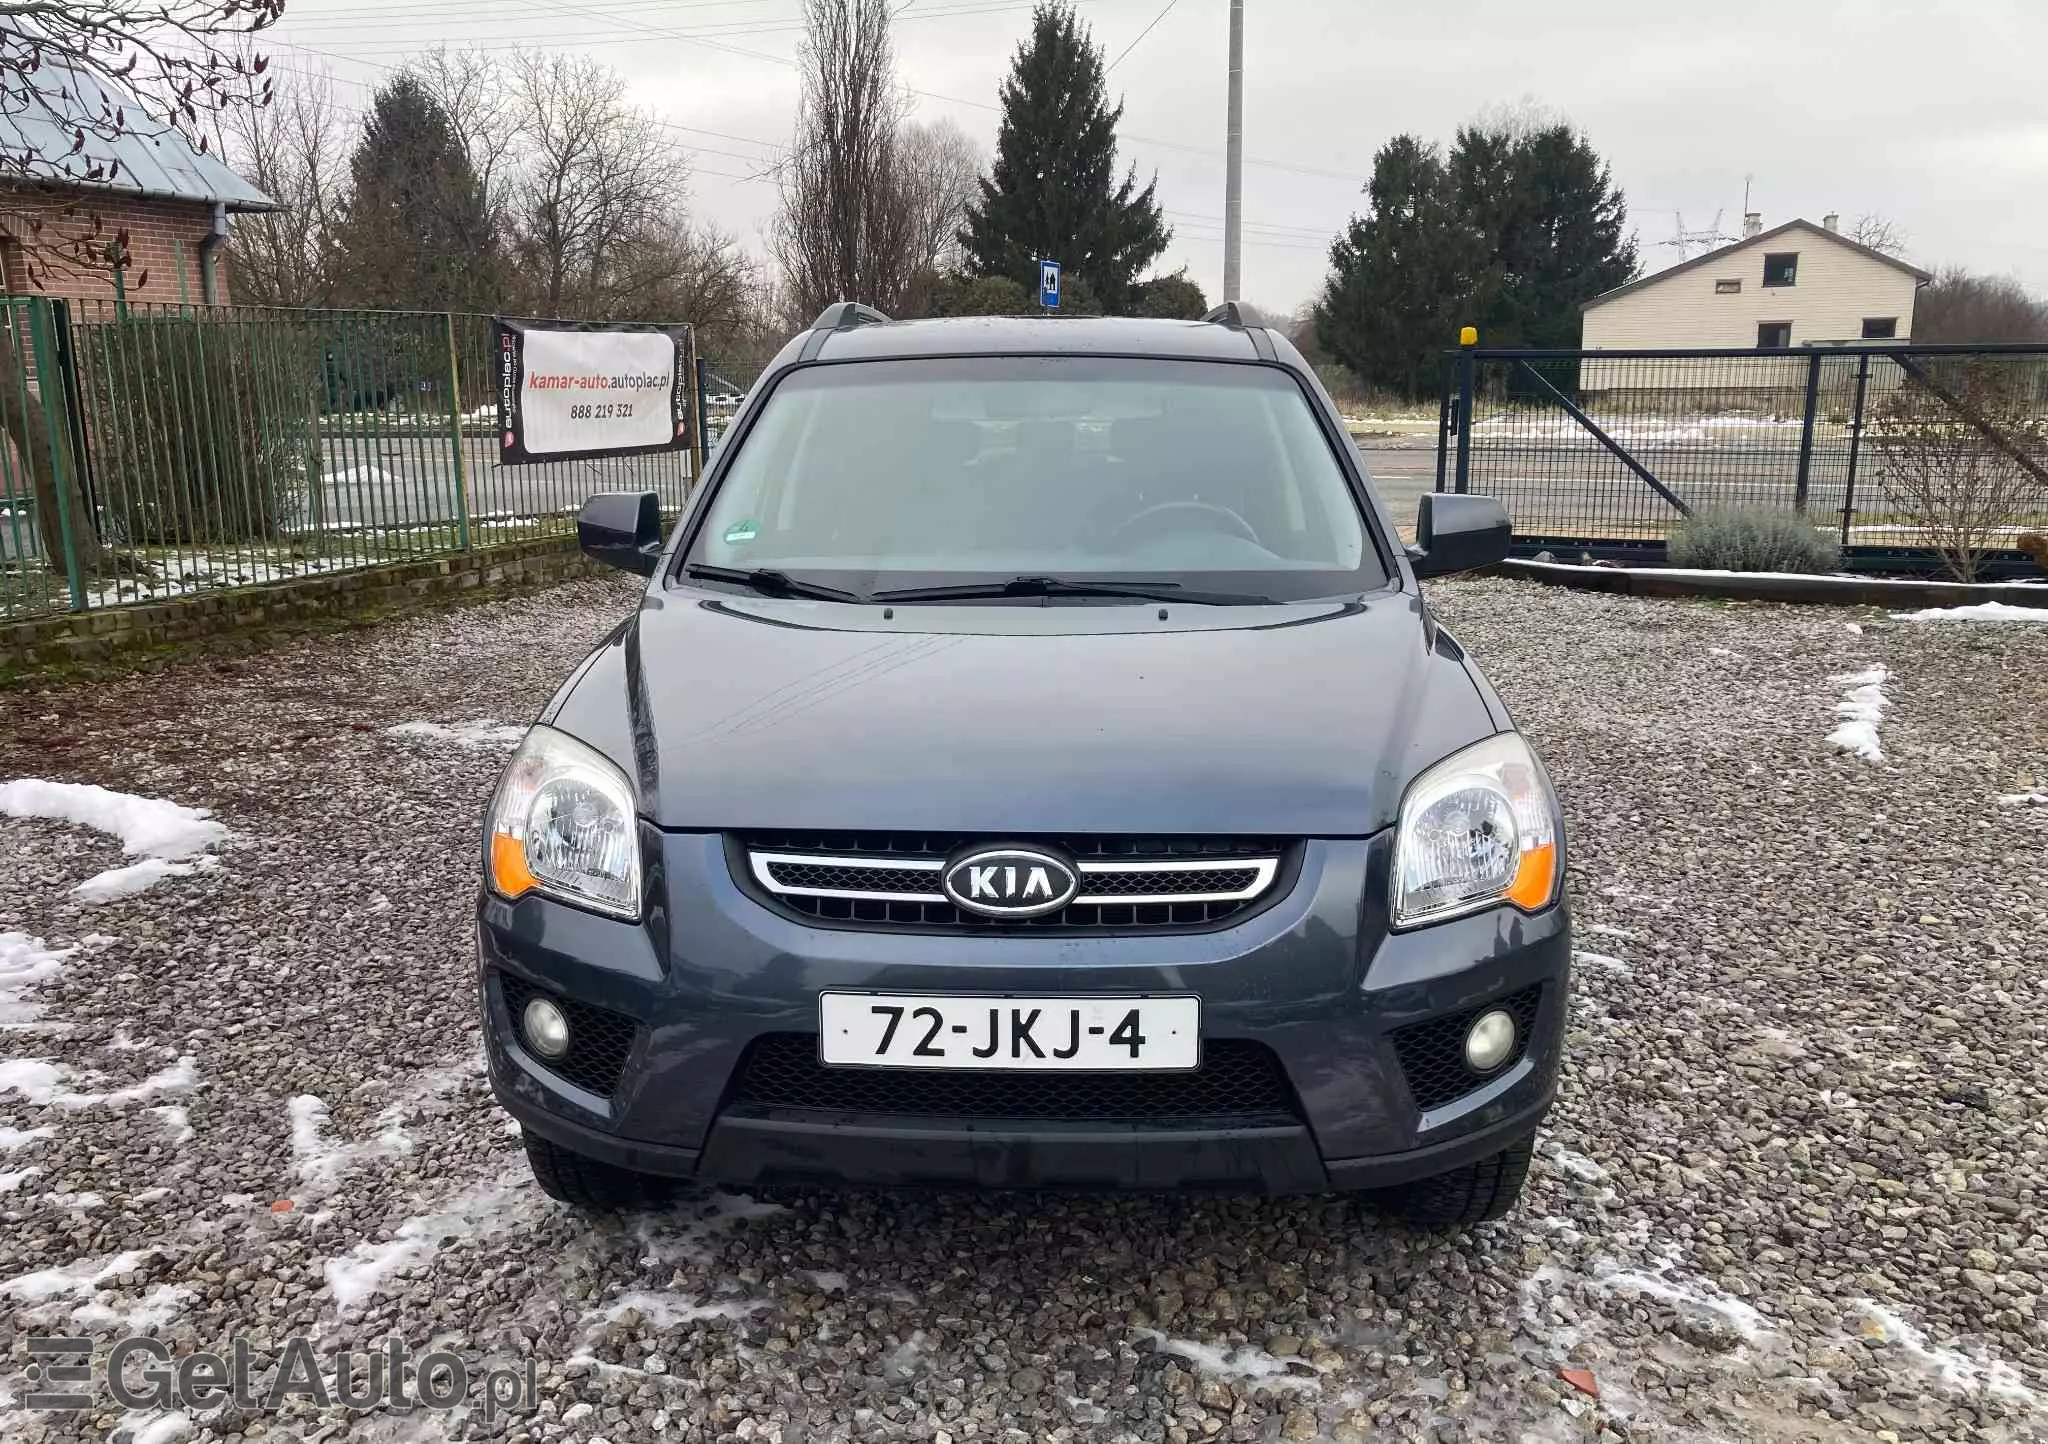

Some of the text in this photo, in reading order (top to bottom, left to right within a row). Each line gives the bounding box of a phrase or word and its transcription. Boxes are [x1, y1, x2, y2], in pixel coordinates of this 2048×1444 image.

[501, 333, 513, 429] autoplac.pl
[528, 369, 670, 393] kamar-auto.autoplac.pl
[570, 403, 633, 420] 888 219 321
[969, 866, 1053, 899] KIA
[871, 1006, 1146, 1059] 72-JKJ-4
